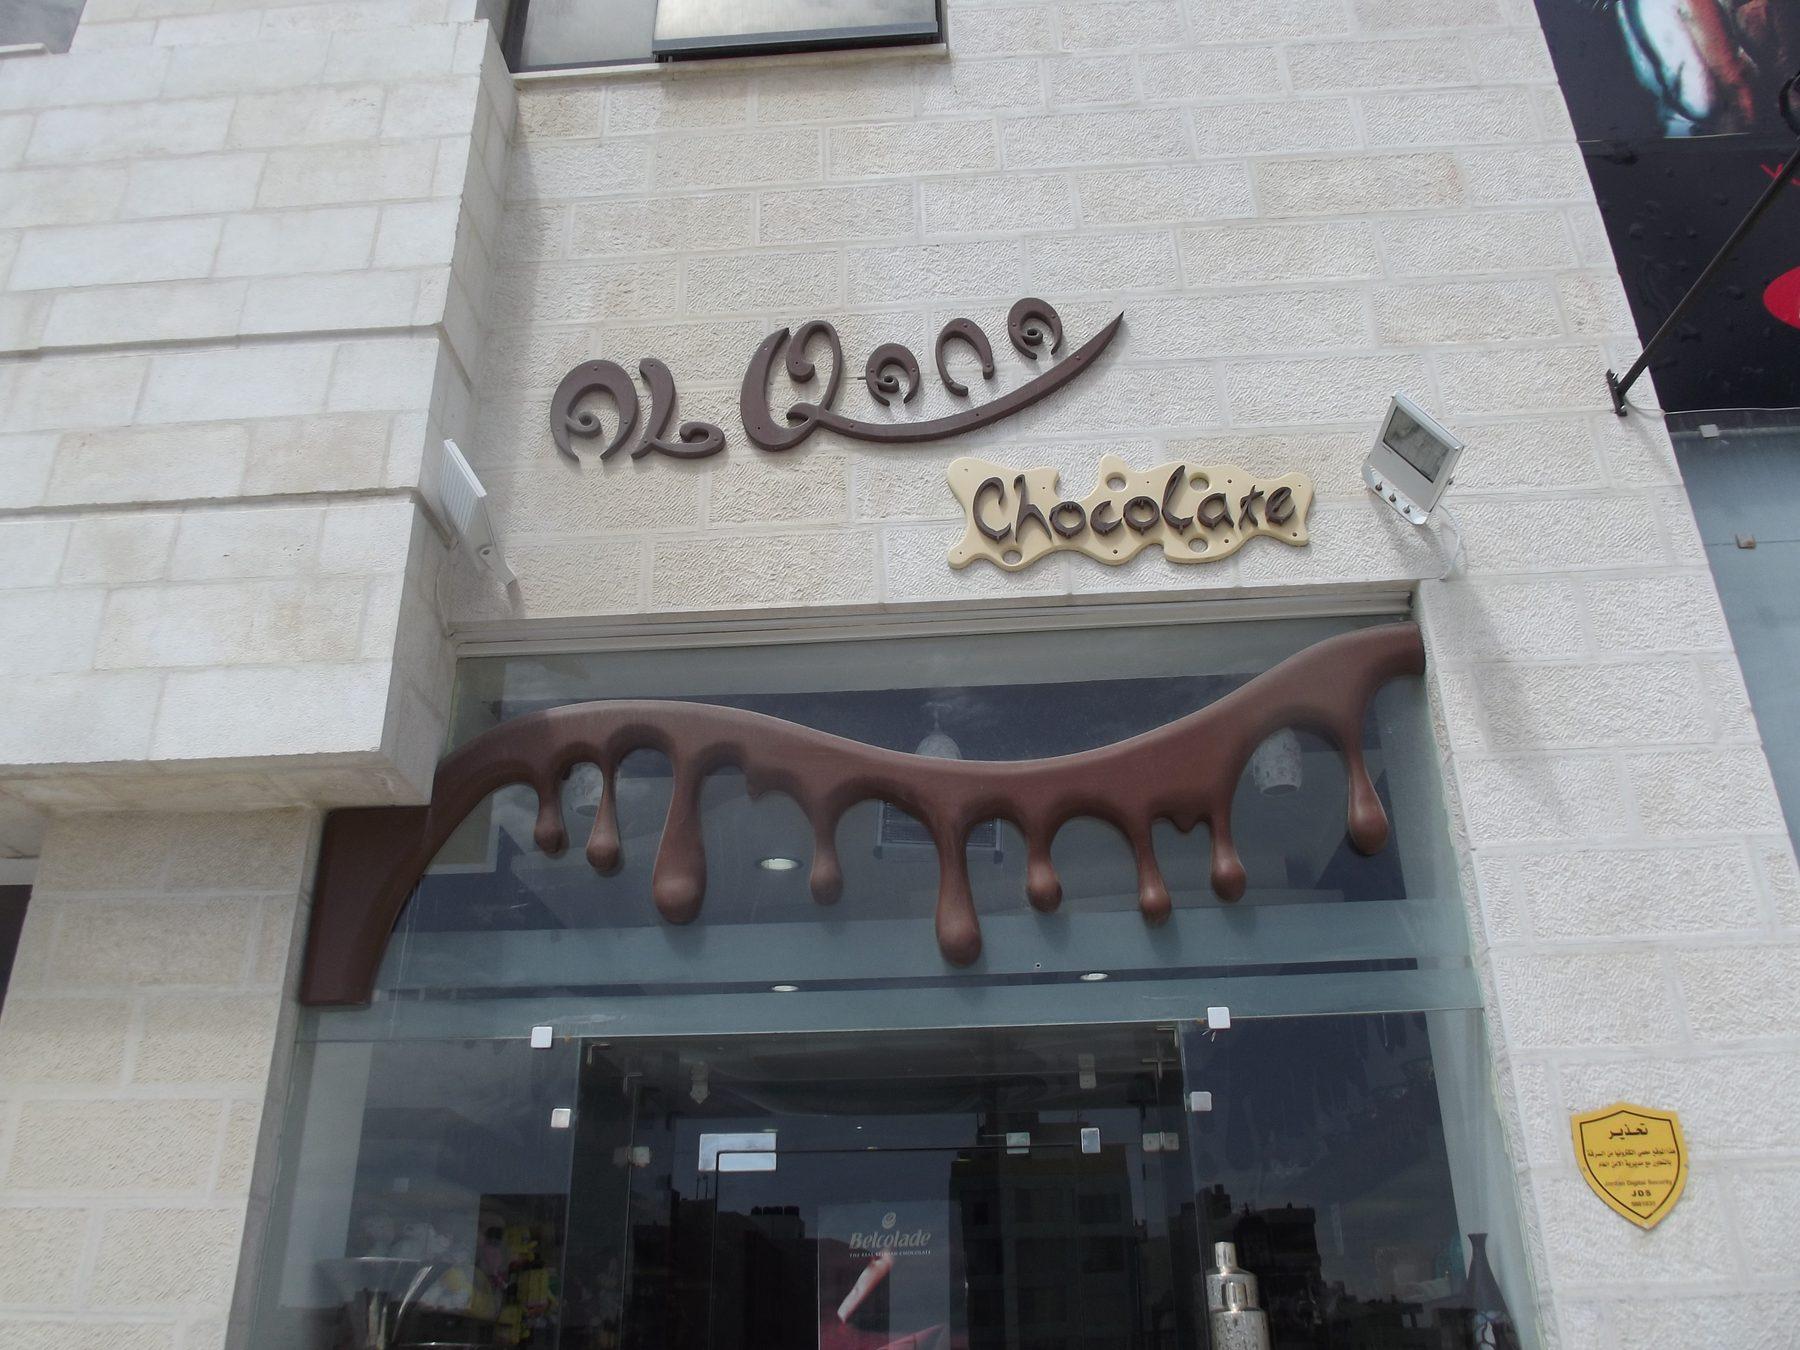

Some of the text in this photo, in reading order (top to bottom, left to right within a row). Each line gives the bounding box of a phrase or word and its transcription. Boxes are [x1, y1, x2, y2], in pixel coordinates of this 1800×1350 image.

[973, 465, 1296, 543] Chocolate
[1608, 1122, 1648, 1140] تحذير
[849, 1229, 932, 1249] Belcolade
